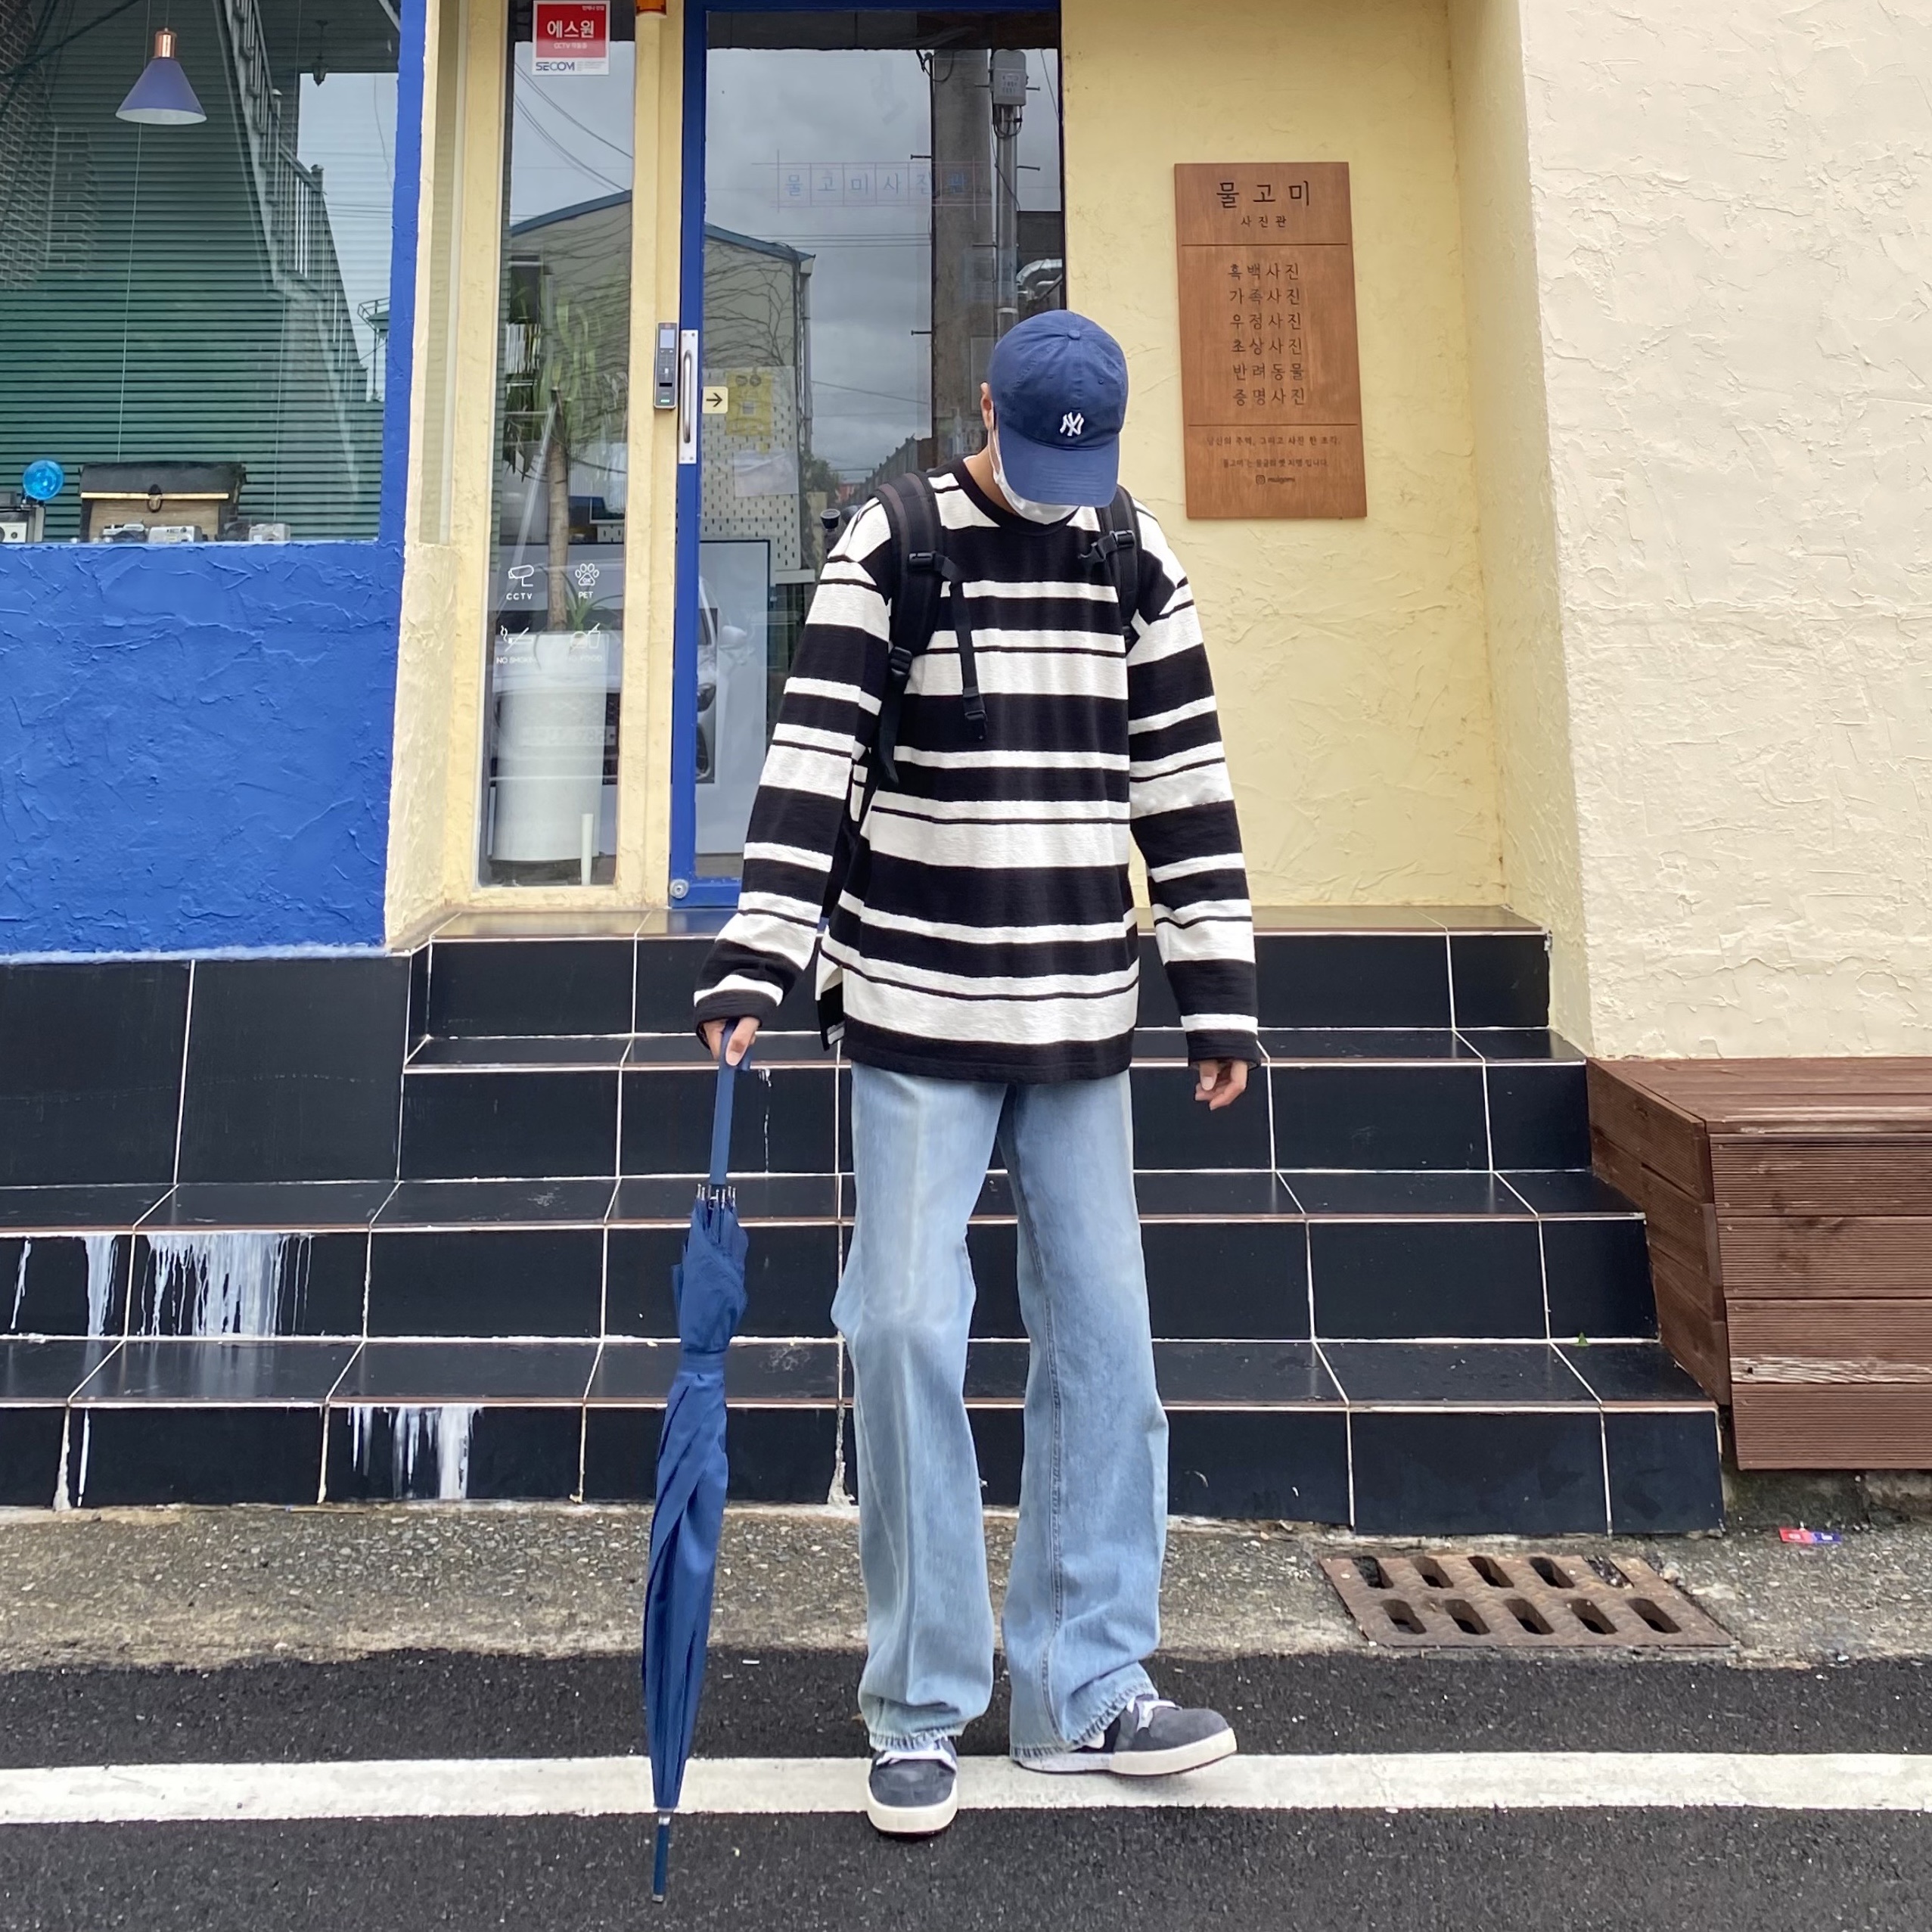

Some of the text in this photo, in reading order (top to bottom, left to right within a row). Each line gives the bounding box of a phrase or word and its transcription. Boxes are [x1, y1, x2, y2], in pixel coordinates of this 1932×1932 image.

[547, 20, 595, 39] 에스원
[536, 61, 575, 71] SECOM
[1216, 180, 1309, 209] 물고미
[1241, 216, 1287, 228] 사진관
[1228, 263, 1299, 281] 흑백사진
[1229, 288, 1300, 306] 가족사진
[1230, 312, 1301, 331] 우정사진
[1232, 337, 1303, 356] 초상사진
[1232, 362, 1304, 381] 반려동물
[1232, 387, 1306, 406] 증명사진
[1060, 412, 1085, 436] NY
